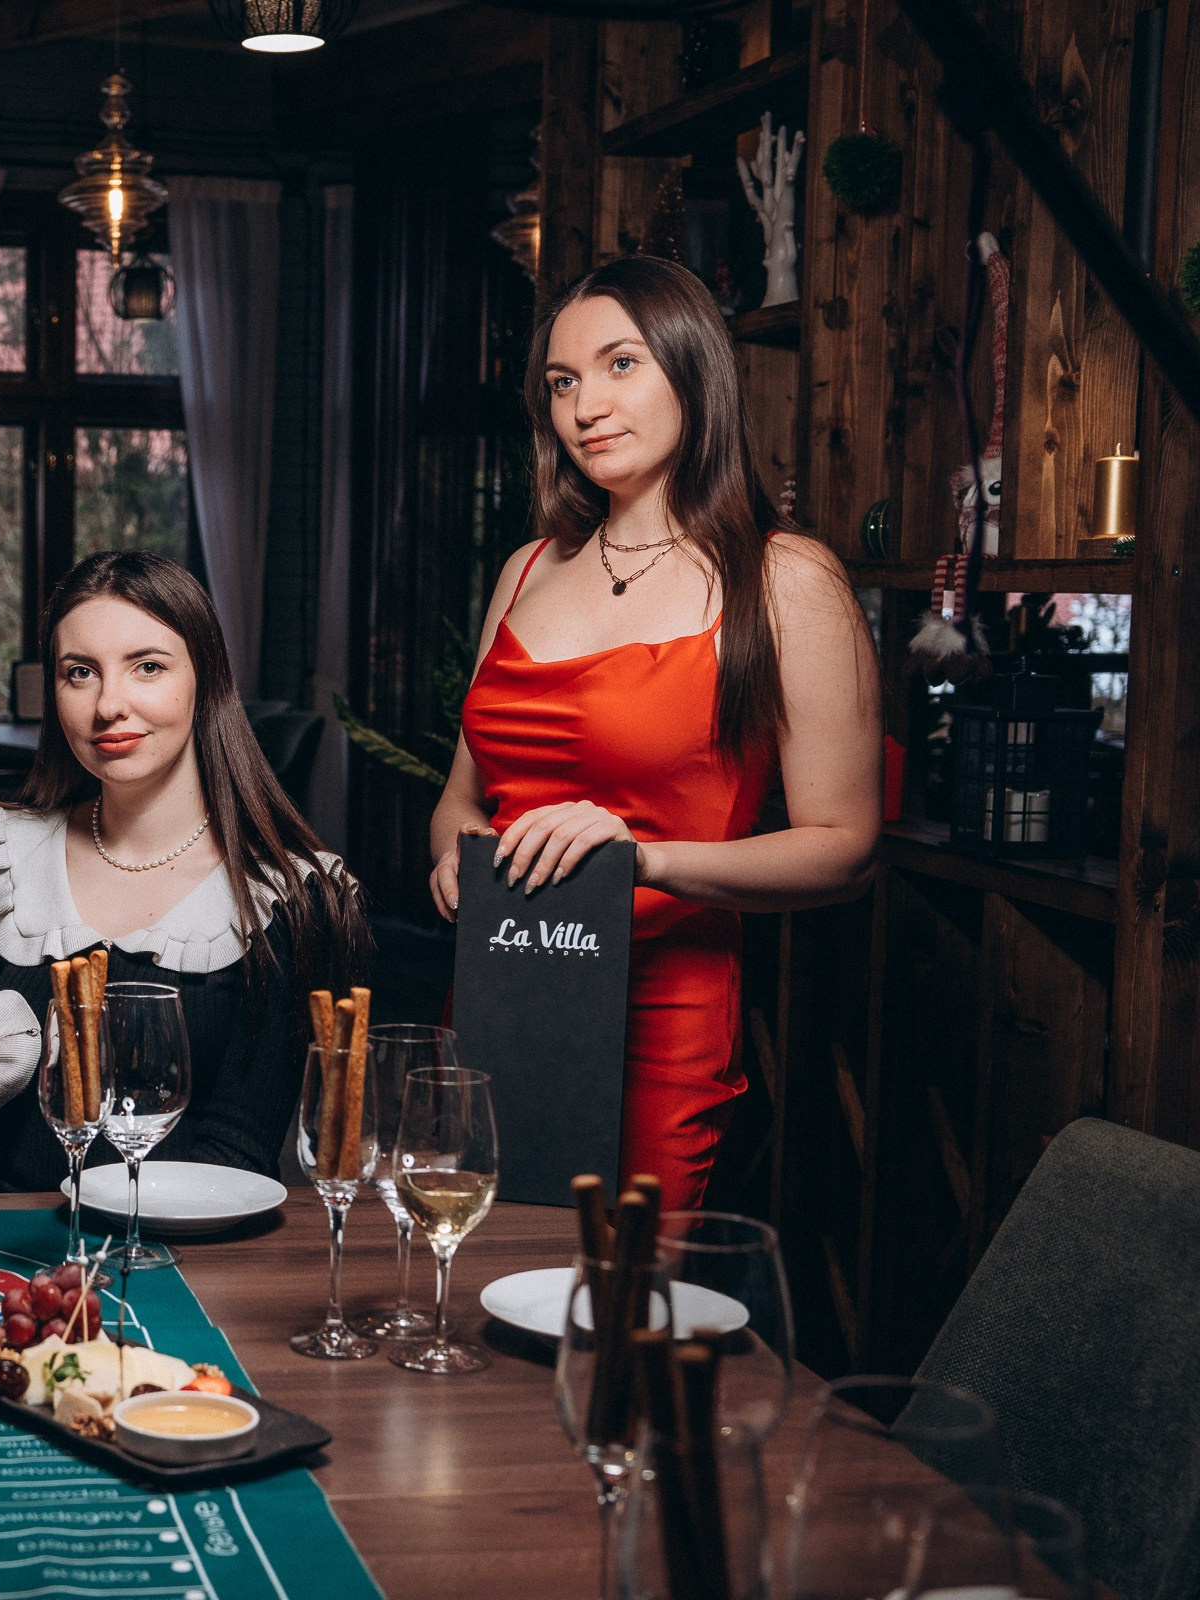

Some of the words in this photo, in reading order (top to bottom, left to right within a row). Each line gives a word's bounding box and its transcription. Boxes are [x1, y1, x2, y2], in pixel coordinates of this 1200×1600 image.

[489, 918, 532, 947] La
[538, 920, 601, 951] Villa
[489, 945, 600, 958] ресторан
